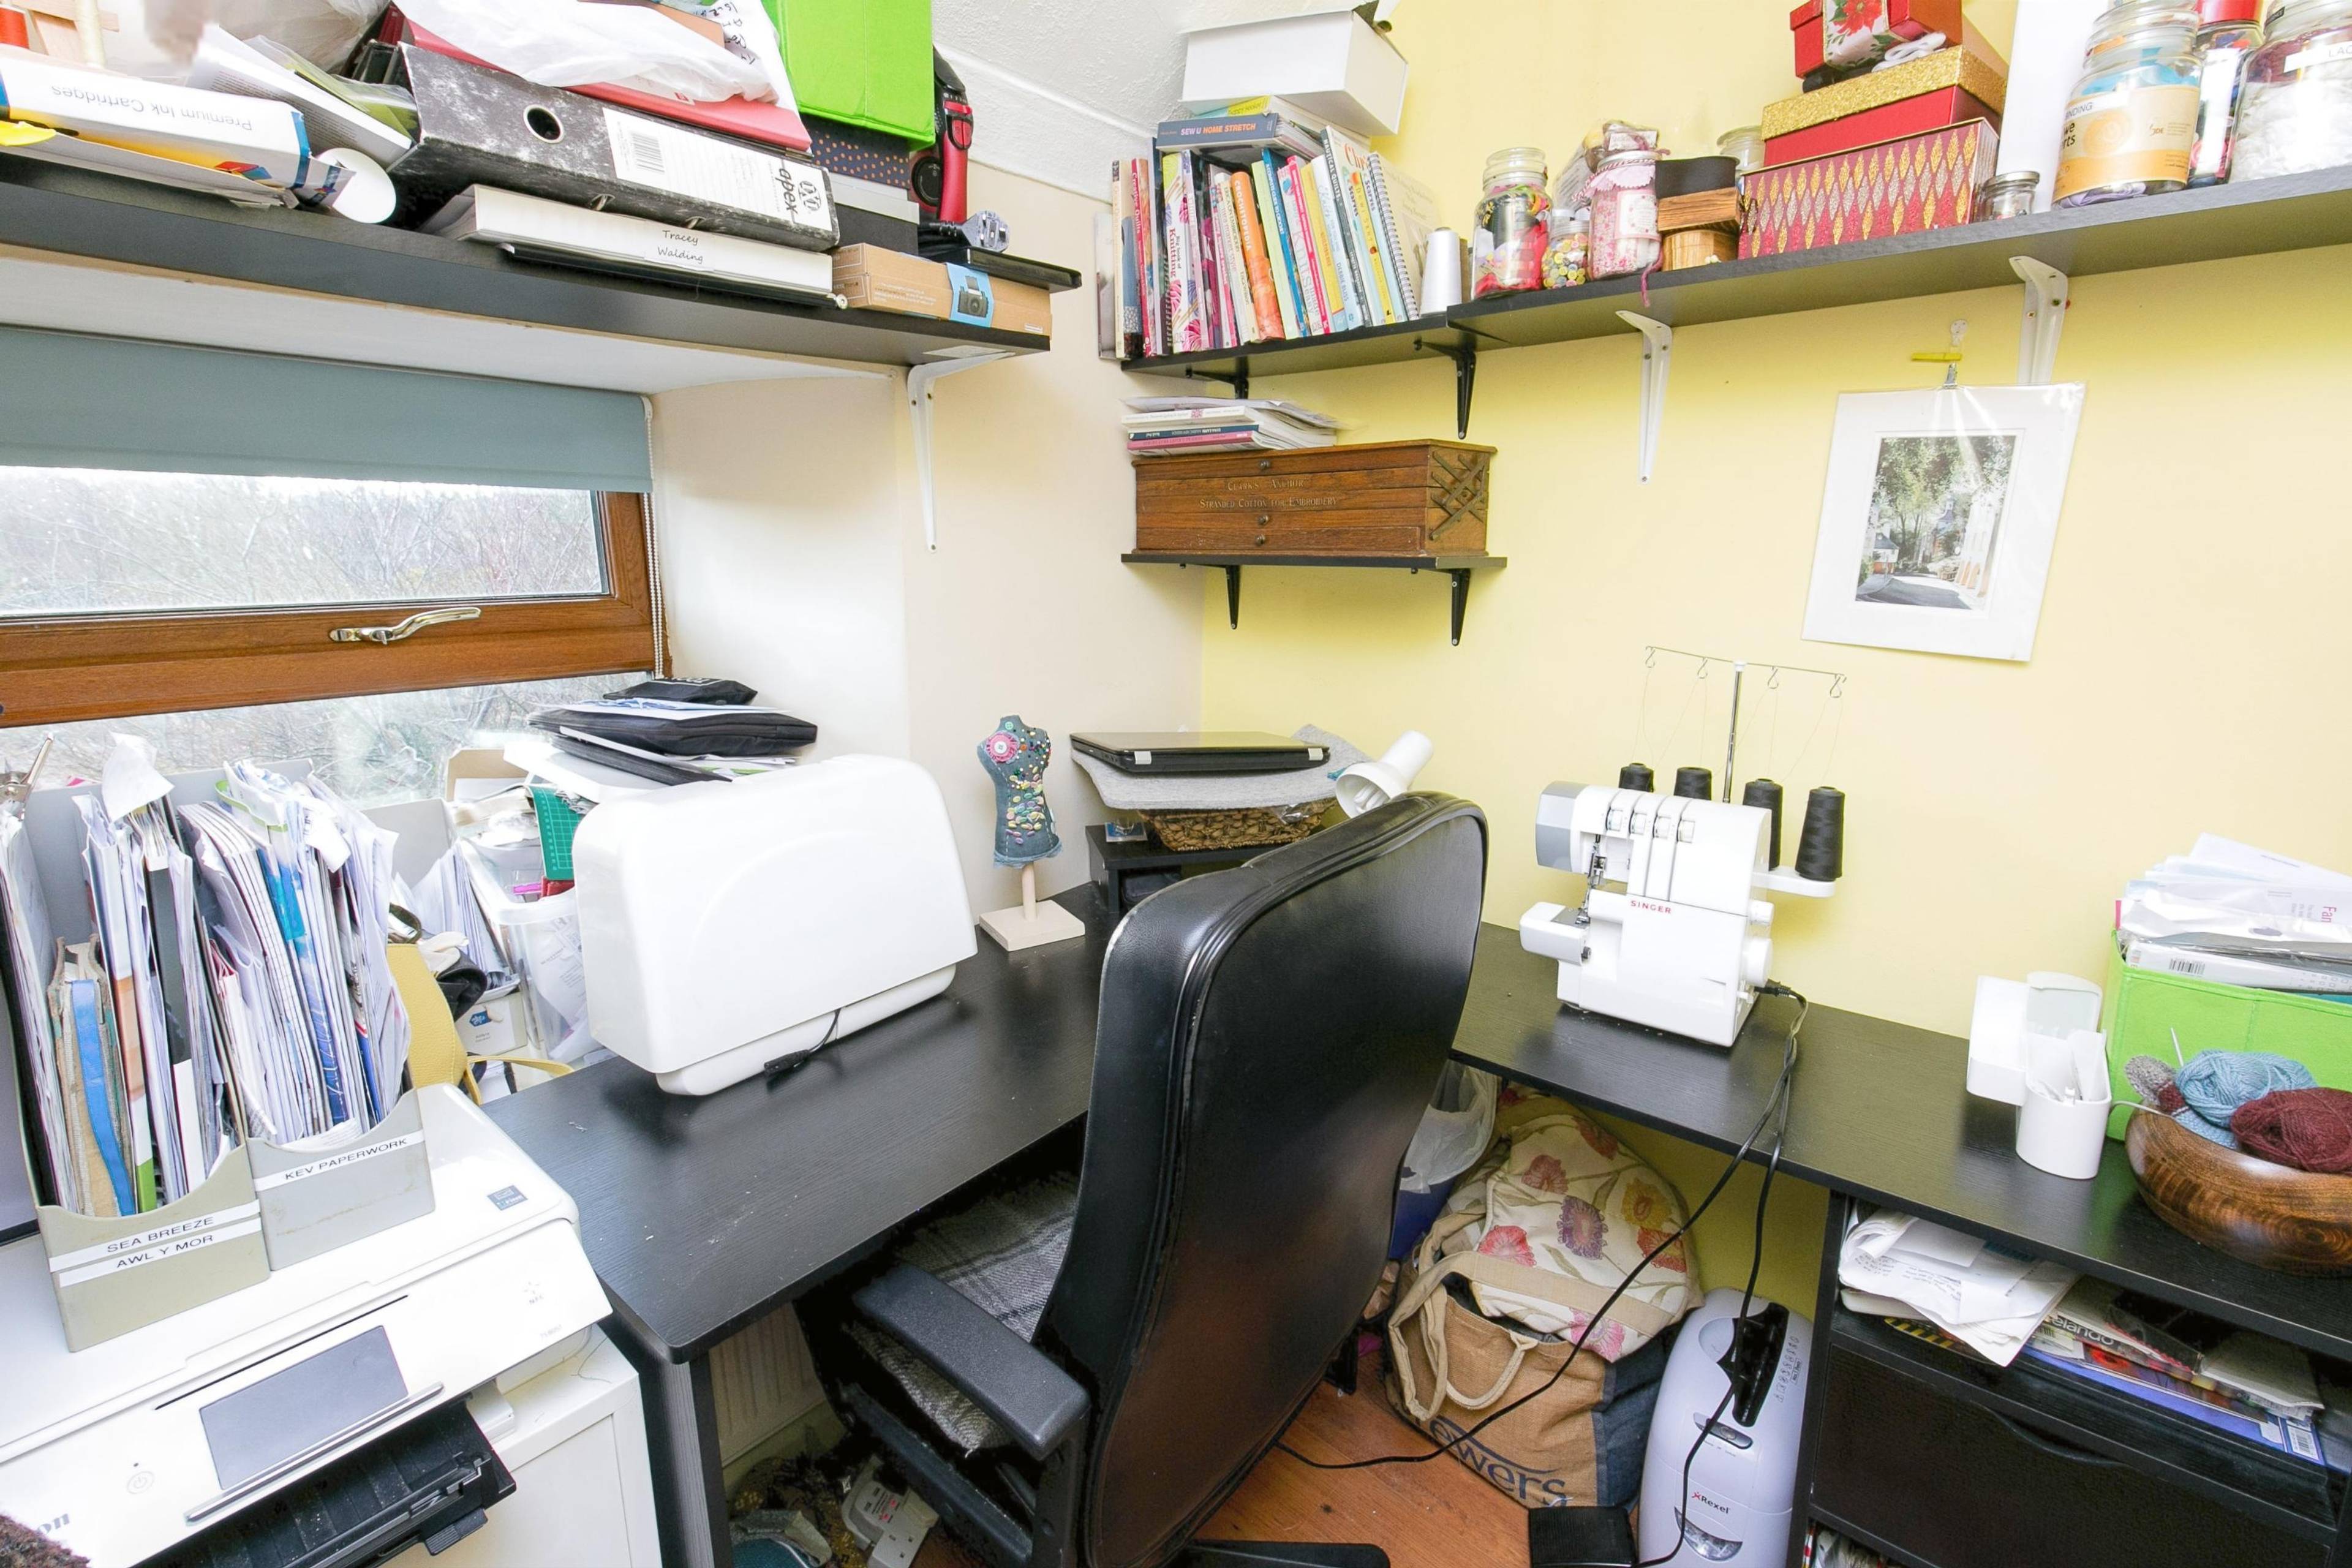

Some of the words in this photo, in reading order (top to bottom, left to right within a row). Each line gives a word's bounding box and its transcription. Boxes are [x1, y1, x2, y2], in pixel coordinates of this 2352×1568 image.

[51, 85, 145, 112] Cartridges
[151, 102, 175, 118] Ink
[180, 106, 252, 131] Premium
[1180, 127, 1196, 136] SEW
[1202, 125, 1223, 134] HOME
[1224, 123, 1256, 132] STRETCH
[1323, 139, 1337, 174] NAUTICAL
[1331, 174, 1341, 202] QUILTS
[775, 168, 798, 214] apex
[1132, 172, 1140, 207] Creative
[1349, 186, 1359, 216] Scarves
[1365, 180, 1375, 211] Scarves
[1235, 179, 1253, 251] CROCHETOPEDIA
[662, 230, 698, 246] Tracey
[657, 246, 703, 264] Walding
[1200, 498, 1235, 508] STRANDED
[1238, 498, 1267, 508] COTTON
[1289, 496, 1337, 507] EMBROIDERY
[1630, 900, 1672, 914] SINGER
[284, 1167, 315, 1181] KEV
[318, 1137, 408, 1170] PAPERWORK
[107, 1237, 142, 1254] SEA
[148, 1216, 214, 1242] BREEZE
[116, 1253, 154, 1268] AWL
[159, 1246, 170, 1257] Y
[176, 1235, 213, 1251] MOR
[1701, 1495, 1729, 1514] Rexel
